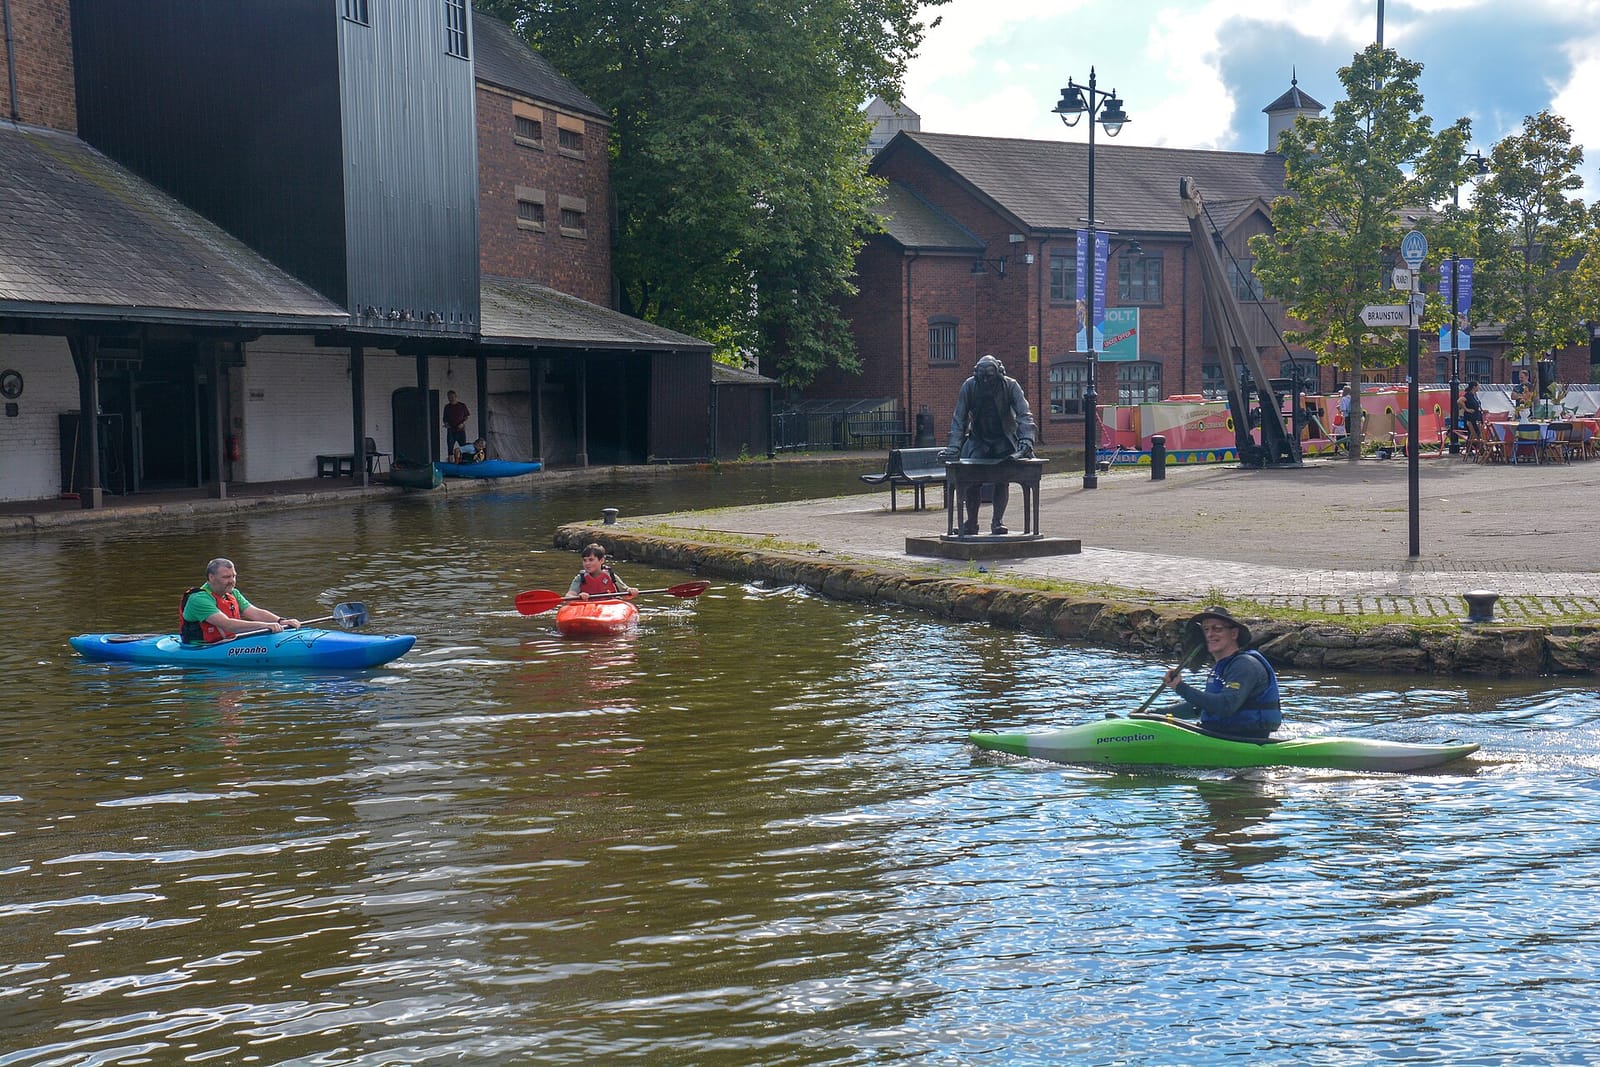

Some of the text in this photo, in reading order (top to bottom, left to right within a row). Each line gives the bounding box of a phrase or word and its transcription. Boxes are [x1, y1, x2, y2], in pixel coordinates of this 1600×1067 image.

[1367, 311, 1403, 320] BRAUNSTON
[228, 646, 267, 656] pyranha
[1096, 733, 1155, 745] perception
